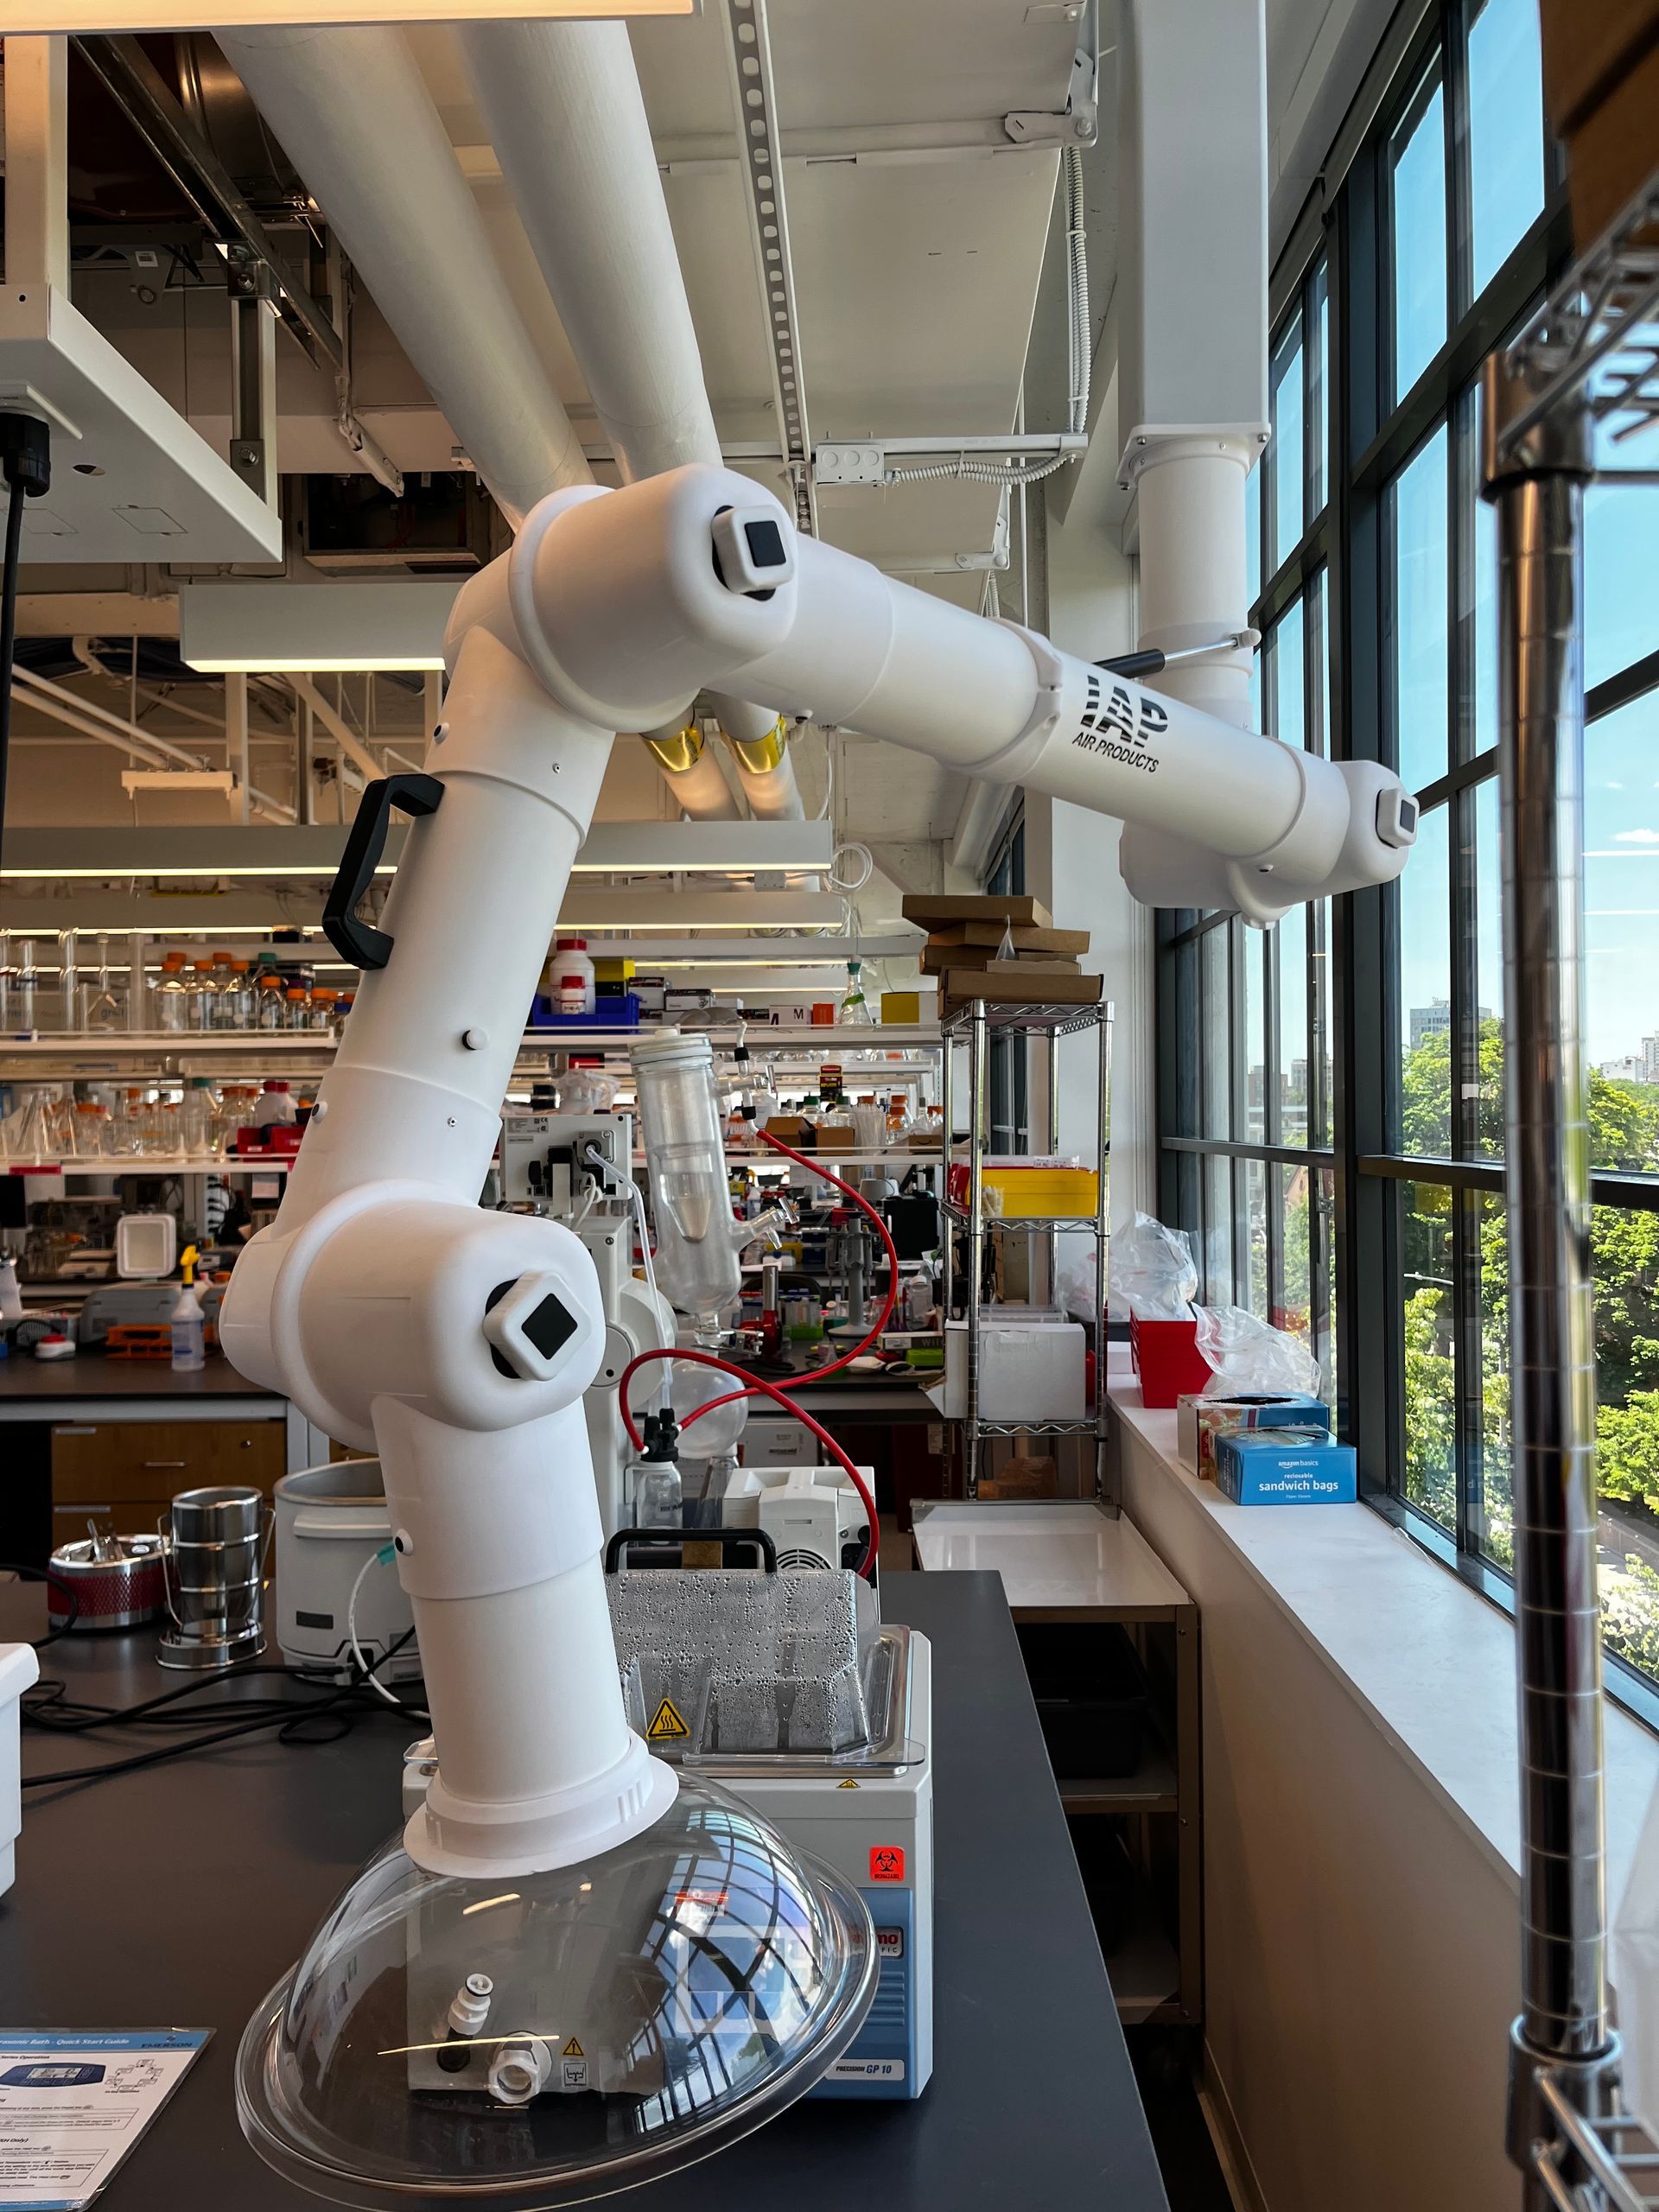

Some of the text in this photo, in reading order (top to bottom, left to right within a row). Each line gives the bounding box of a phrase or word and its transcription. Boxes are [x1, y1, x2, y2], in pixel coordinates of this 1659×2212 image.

[1072, 732, 1160, 772] AIR PRODUCTS
[794, 1007, 804, 1020] M
[1259, 1479, 1338, 1492] sandwich bags
[866, 2064, 880, 2074] GP
[880, 2064, 893, 2074] 10
